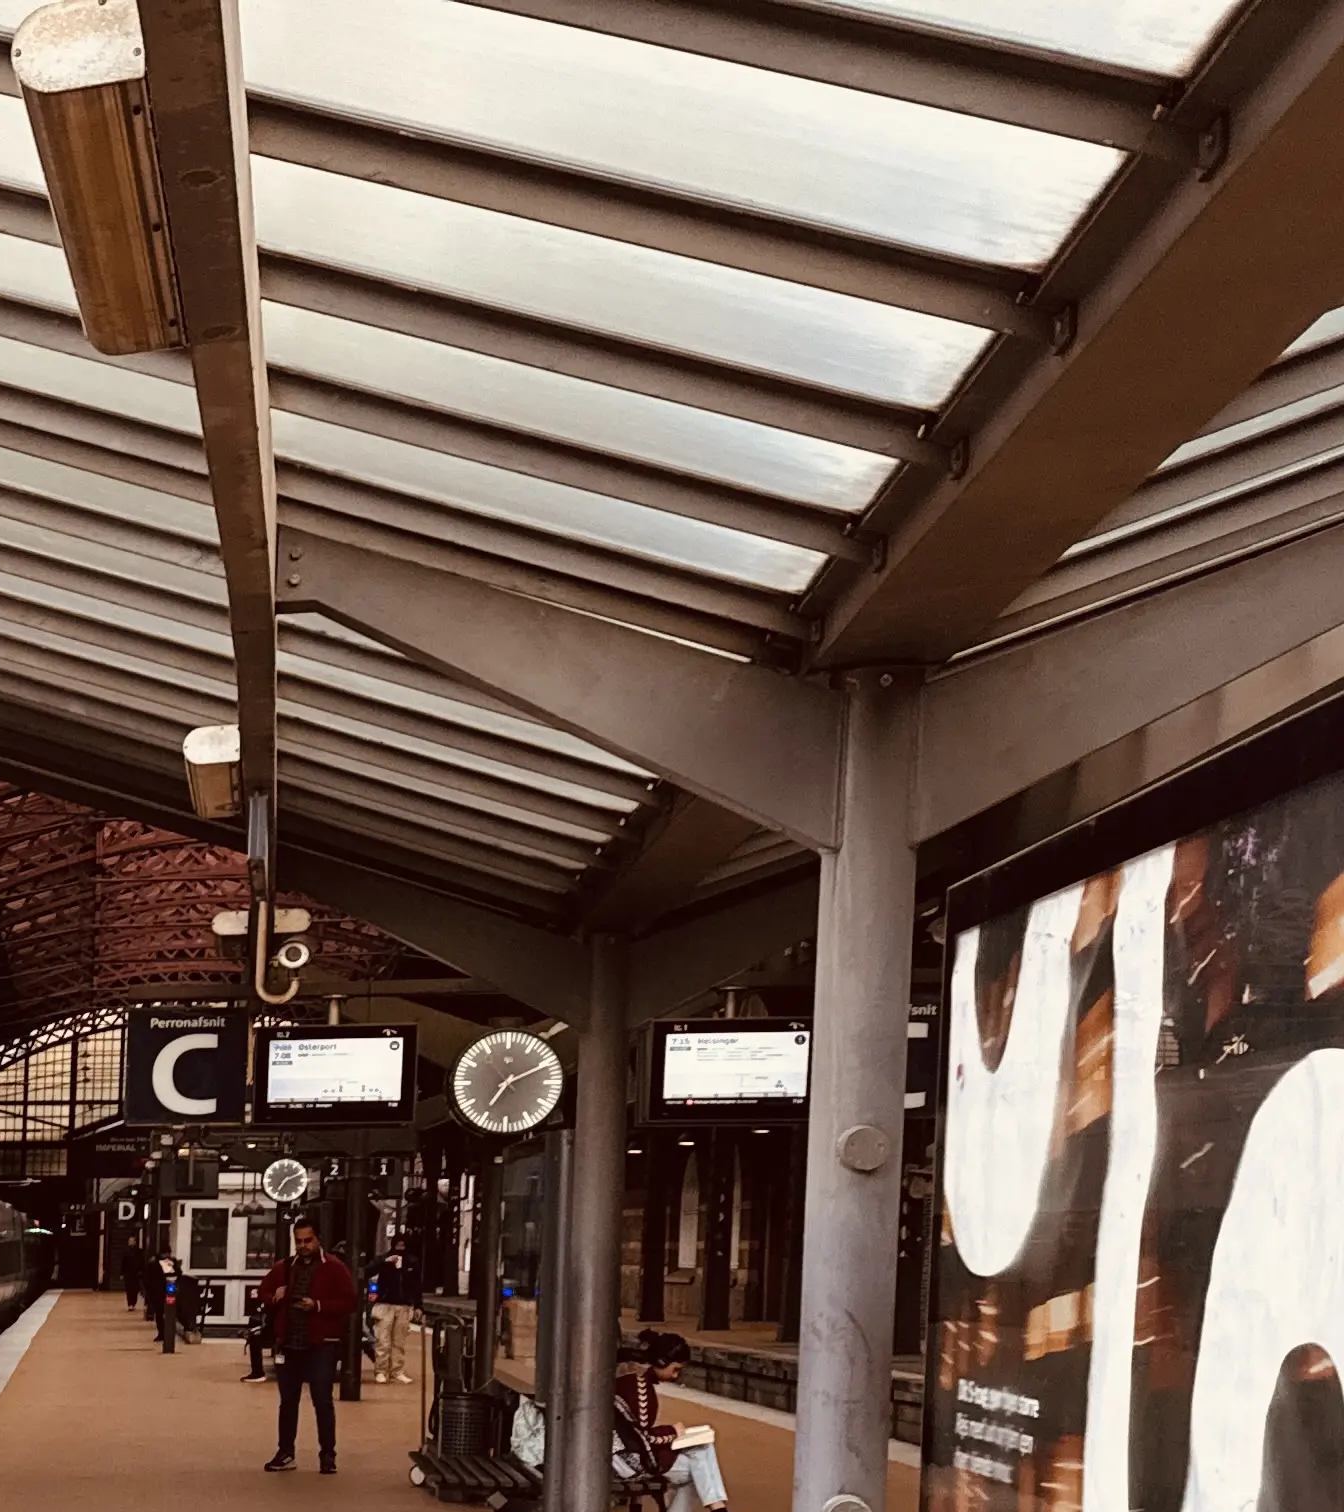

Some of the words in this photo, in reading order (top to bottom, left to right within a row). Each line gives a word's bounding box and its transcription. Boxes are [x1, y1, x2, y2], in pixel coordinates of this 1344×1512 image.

[150, 1016, 227, 1030] Perronafsnit
[152, 1033, 219, 1116] C
[118, 1201, 136, 1221] D
